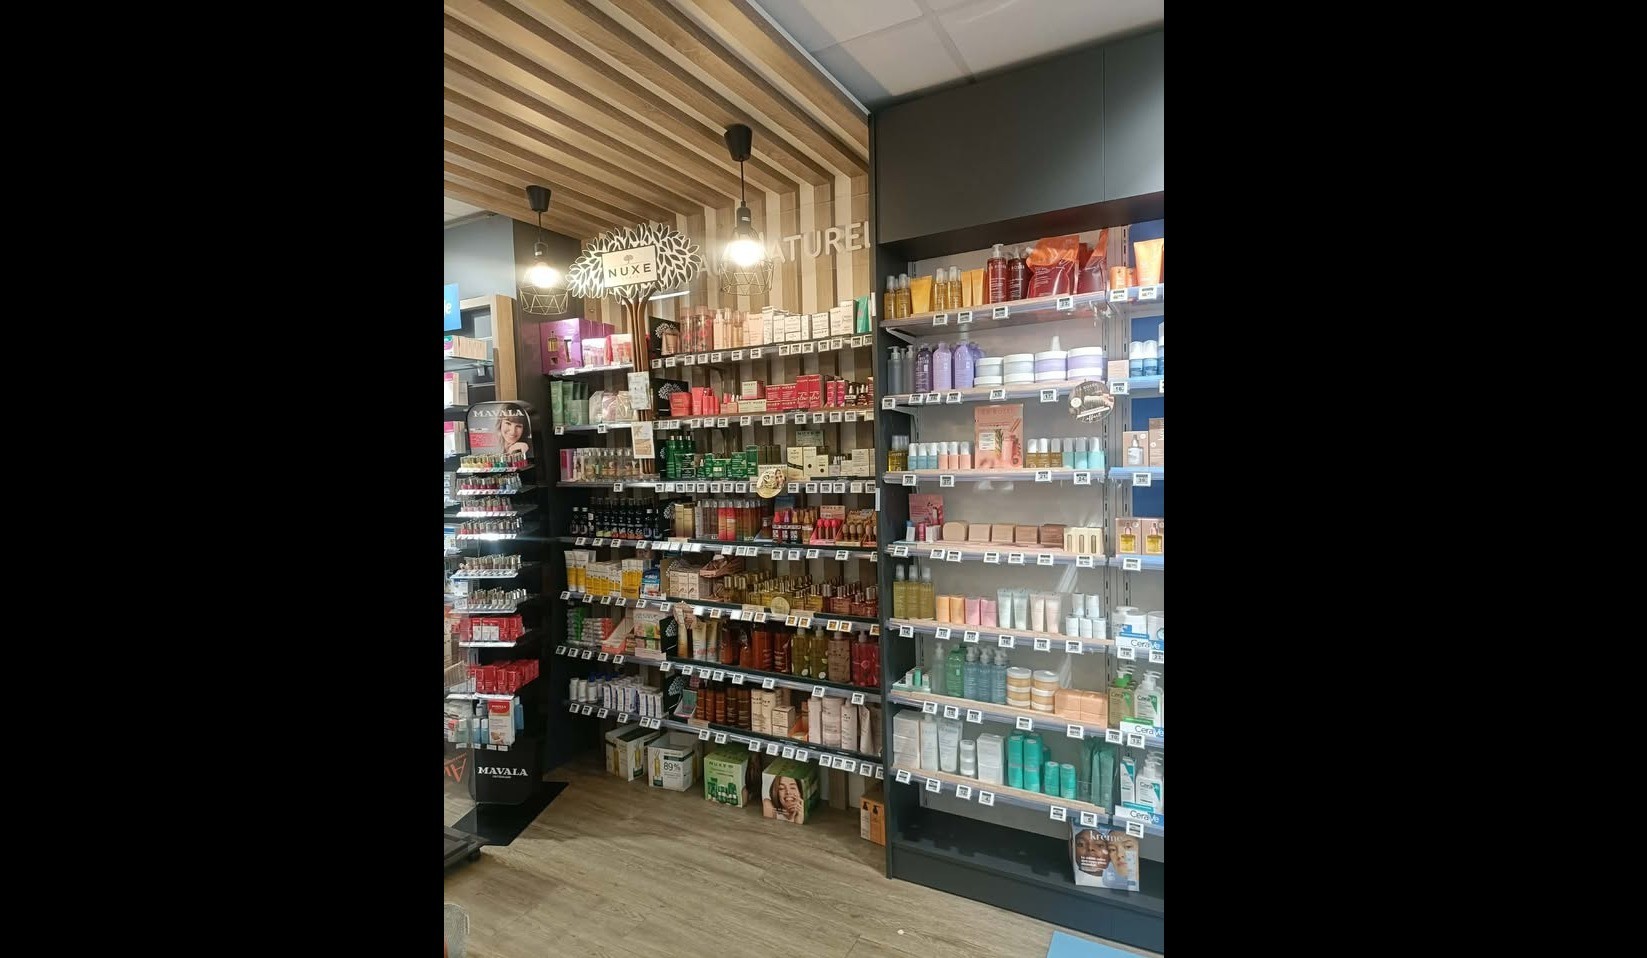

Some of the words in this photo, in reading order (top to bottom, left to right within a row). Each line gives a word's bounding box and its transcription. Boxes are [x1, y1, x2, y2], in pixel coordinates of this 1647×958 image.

[608, 263, 652, 278] NUXE
[473, 409, 525, 417] MAVALA
[478, 766, 528, 776] MAVALA
[1130, 810, 1160, 824] CeraVe
